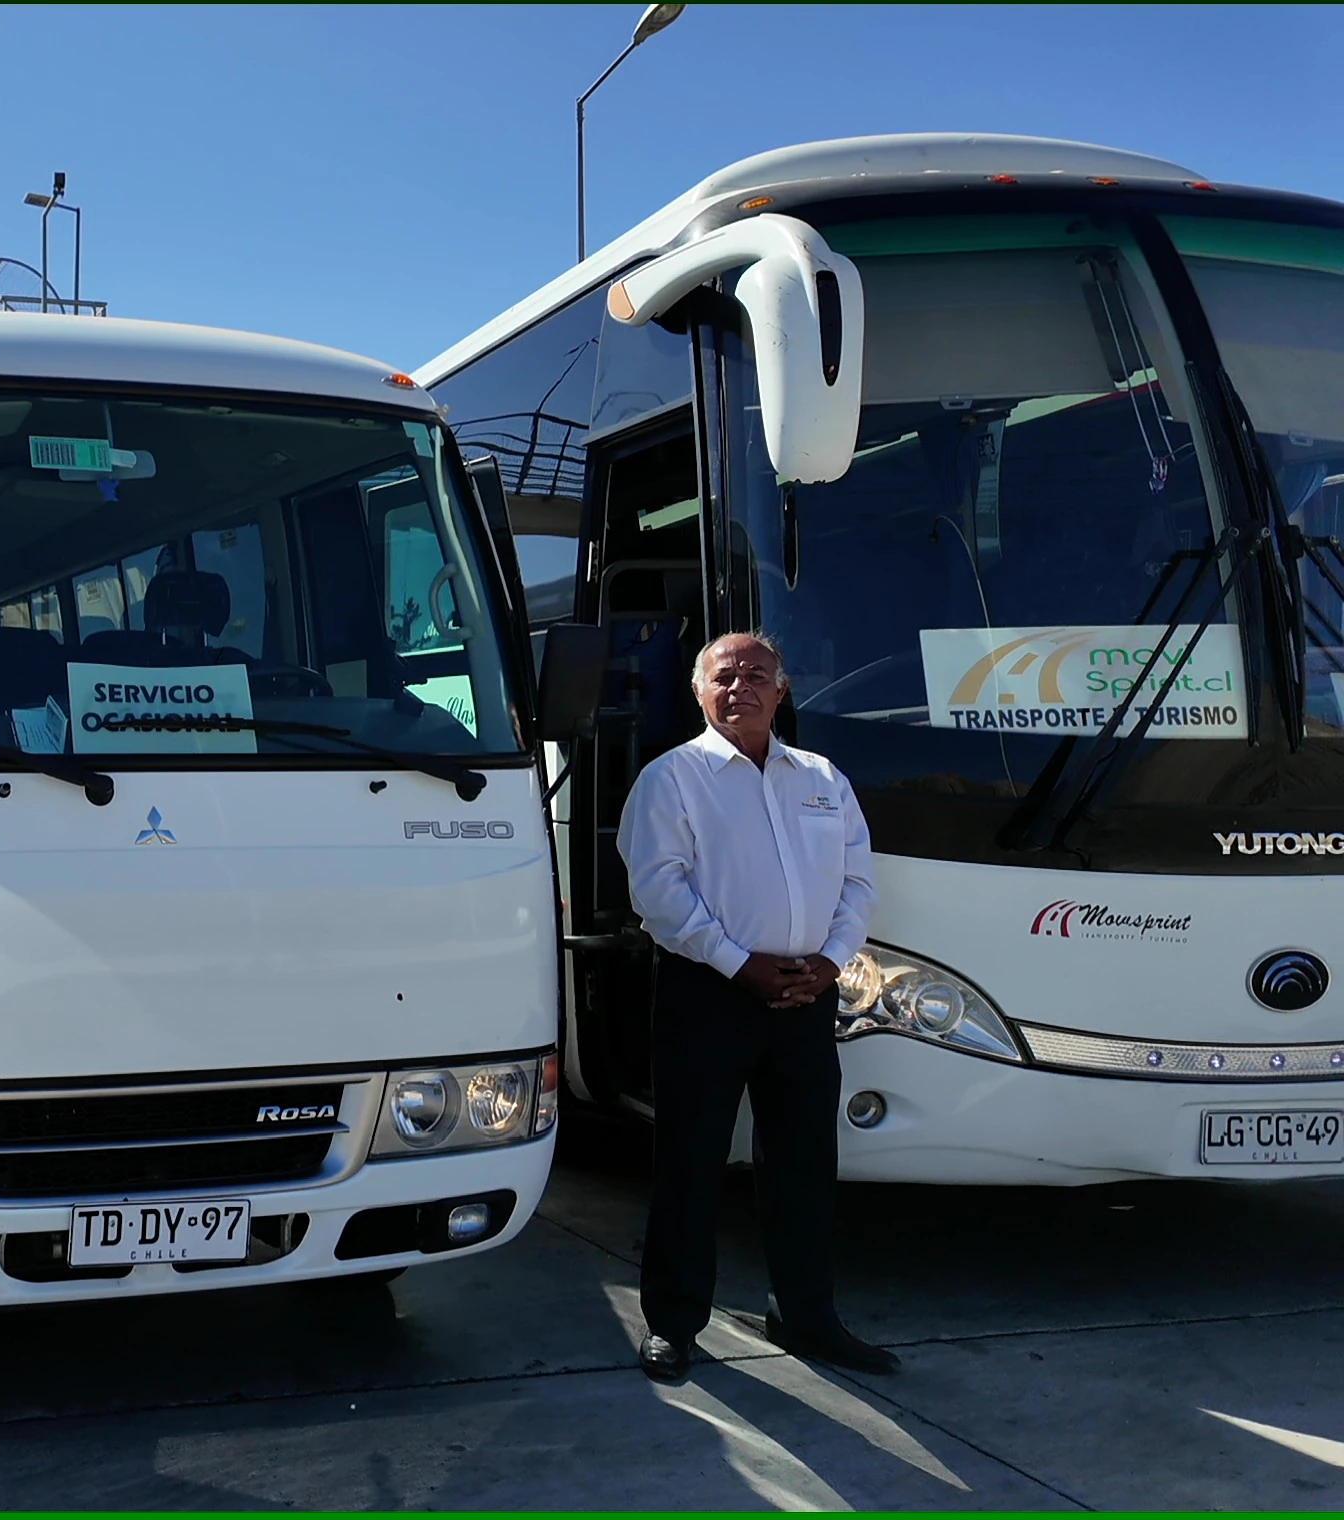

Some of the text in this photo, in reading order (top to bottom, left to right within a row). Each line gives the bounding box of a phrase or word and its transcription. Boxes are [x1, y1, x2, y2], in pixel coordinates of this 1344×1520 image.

[94, 683, 215, 703] SERVICIO
[949, 708, 1106, 728] TRANSPORTE
[1135, 706, 1238, 726] TURISMO
[403, 821, 514, 839] FUSO
[1213, 832, 1344, 855] YUTONG
[256, 1105, 335, 1123] ROSA
[1252, 1152, 1298, 1160] CHILE
[130, 1249, 188, 1260] CHILE
